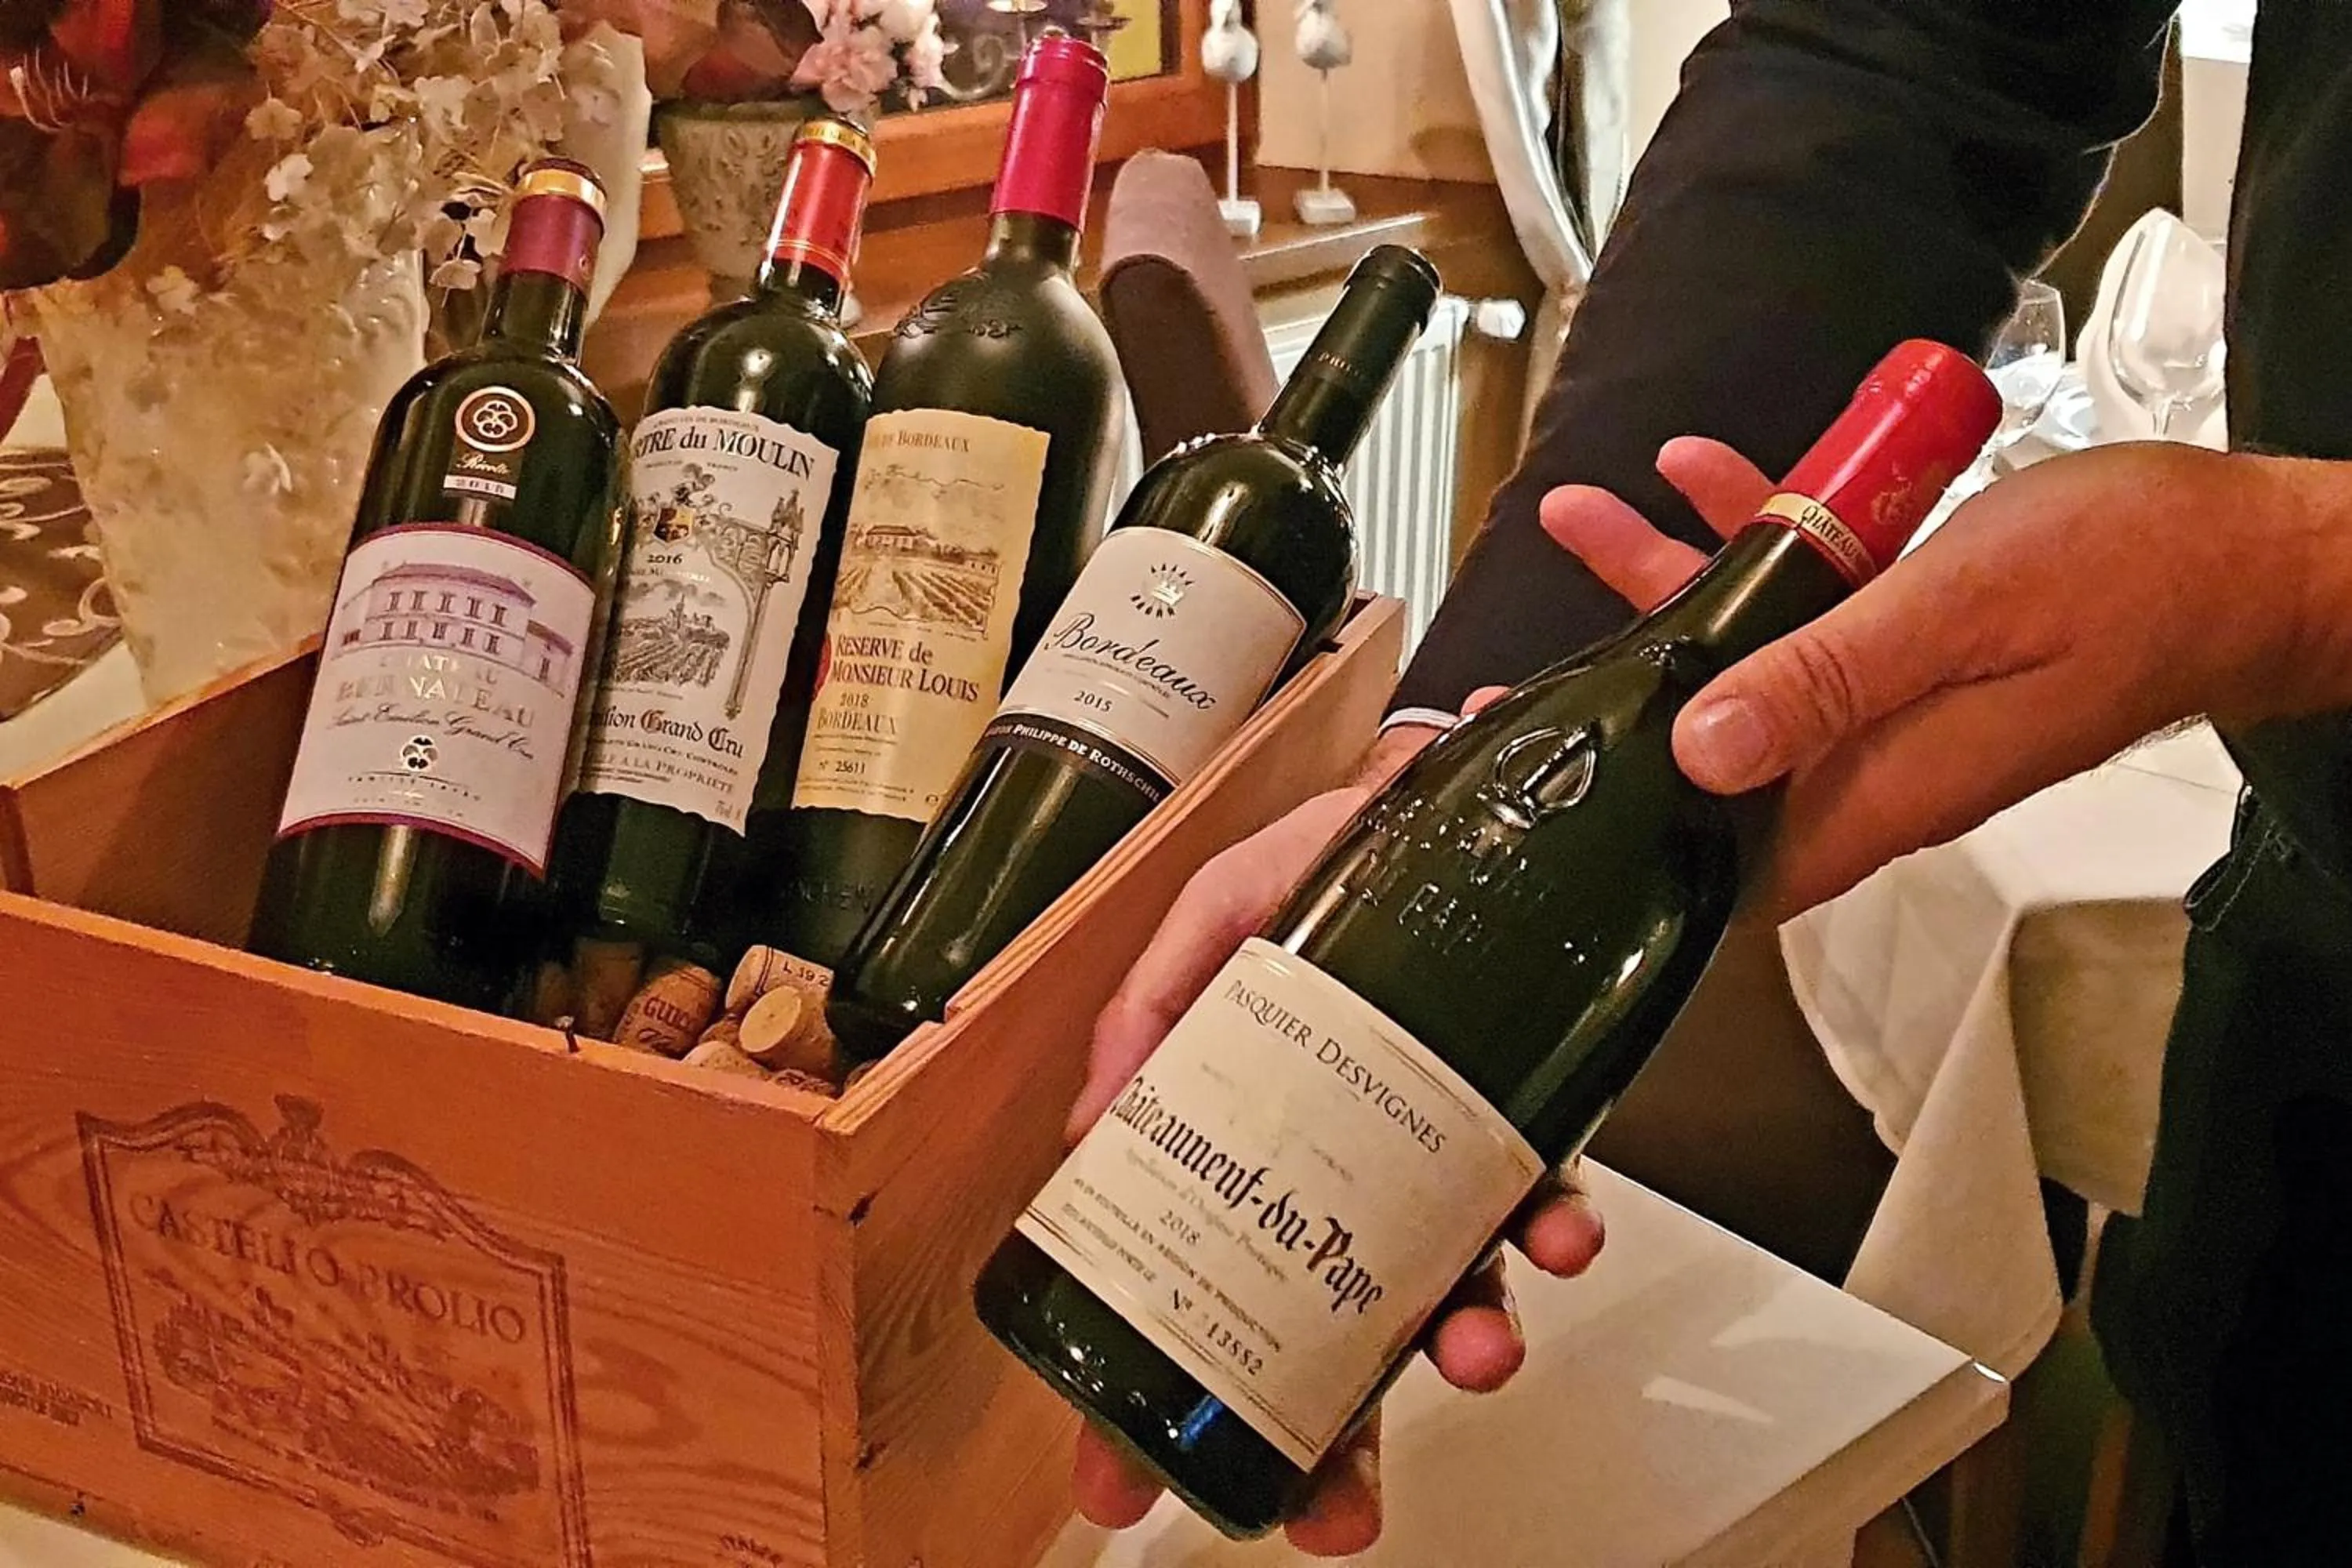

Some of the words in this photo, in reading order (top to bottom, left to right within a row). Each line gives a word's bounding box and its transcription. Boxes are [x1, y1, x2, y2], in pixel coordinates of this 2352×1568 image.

[680, 426, 707, 449] du
[713, 428, 815, 480] MOULIN
[898, 430, 970, 453] BORDEAUX
[648, 552, 683, 564] 2016
[909, 641, 933, 665] de
[1054, 612, 1217, 710] Bordeaux
[832, 659, 913, 689] MONSIEUR
[919, 669, 979, 702] LOUIS
[1074, 691, 1112, 713] 2015
[641, 709, 703, 742] Grand
[708, 726, 744, 759] Cru
[818, 706, 897, 735] BORDEAUX
[1013, 723, 1067, 747] PHILIPPE
[1068, 739, 1087, 756] DE
[1090, 749, 1161, 803] ROTHSCHIL
[1224, 979, 1312, 1048] PASQUIER
[1316, 1036, 1446, 1154] DESVIGNES
[1158, 1210, 1201, 1247] 2018
[1207, 1322, 1264, 1377] 13552
